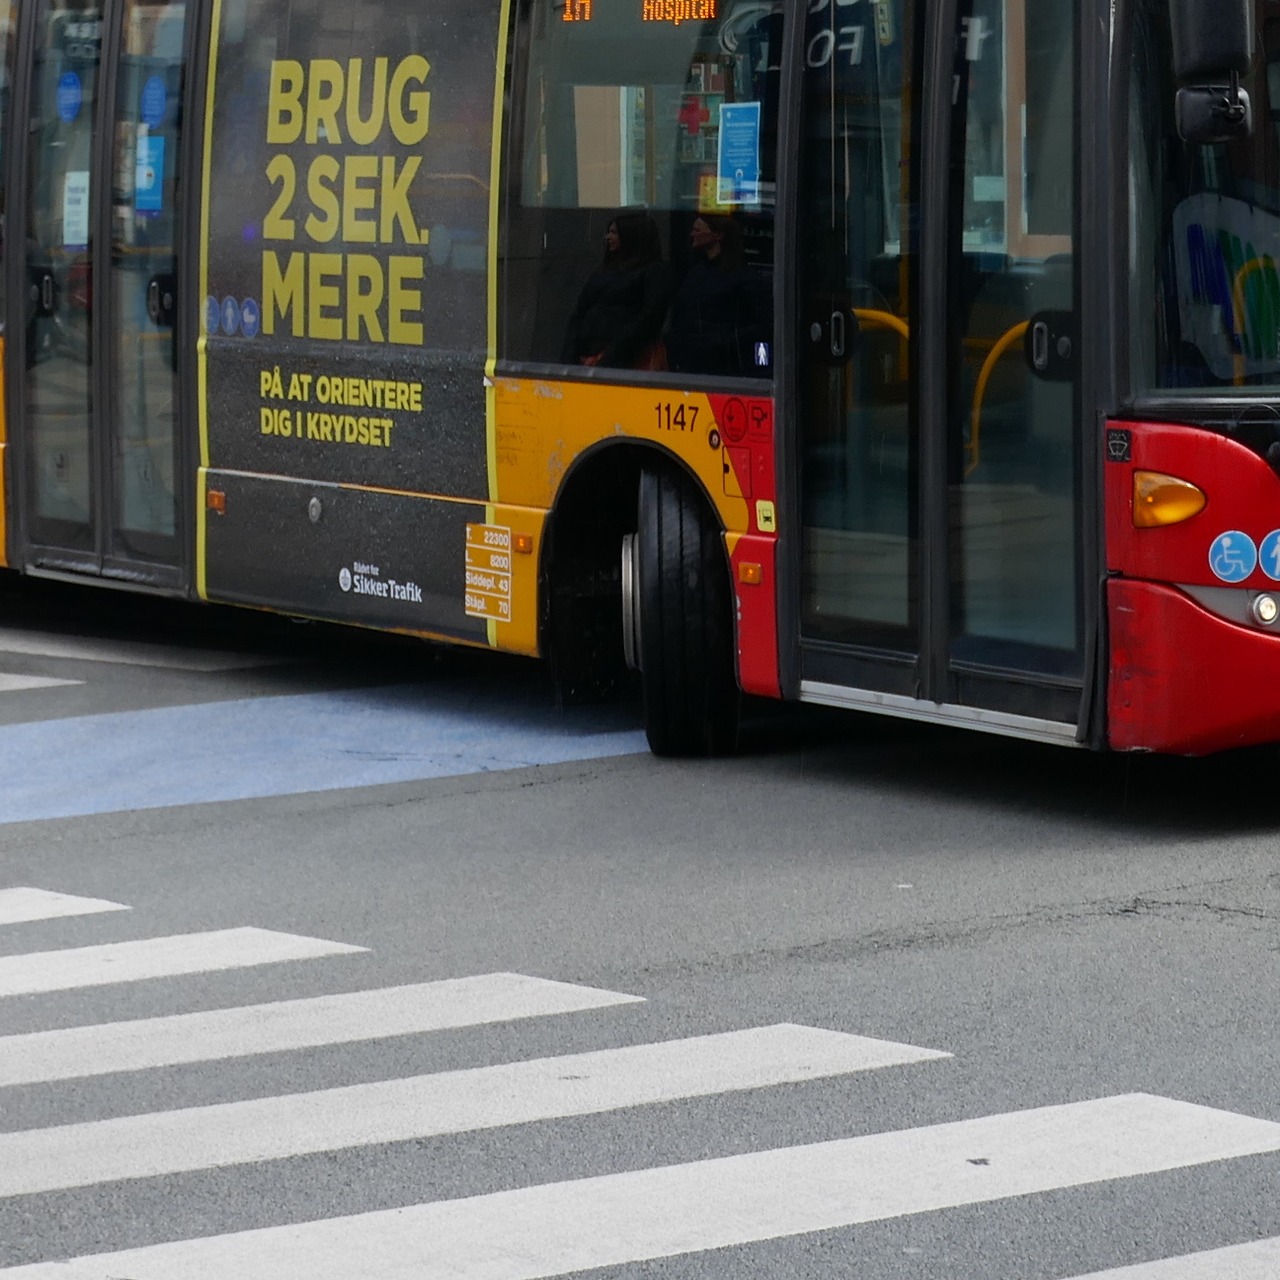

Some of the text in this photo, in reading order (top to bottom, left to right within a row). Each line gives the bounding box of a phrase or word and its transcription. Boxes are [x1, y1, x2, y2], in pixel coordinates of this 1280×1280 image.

[265, 53, 432, 146] BRUG
[263, 154, 430, 246] 2 SEK.
[261, 250, 424, 346] MERE
[260, 367, 423, 412] PÅ AT ORIENTERE
[260, 409, 394, 447] DIG I KRYDSET
[655, 401, 699, 433] 1147
[465, 571, 497, 591] Siddepl.
